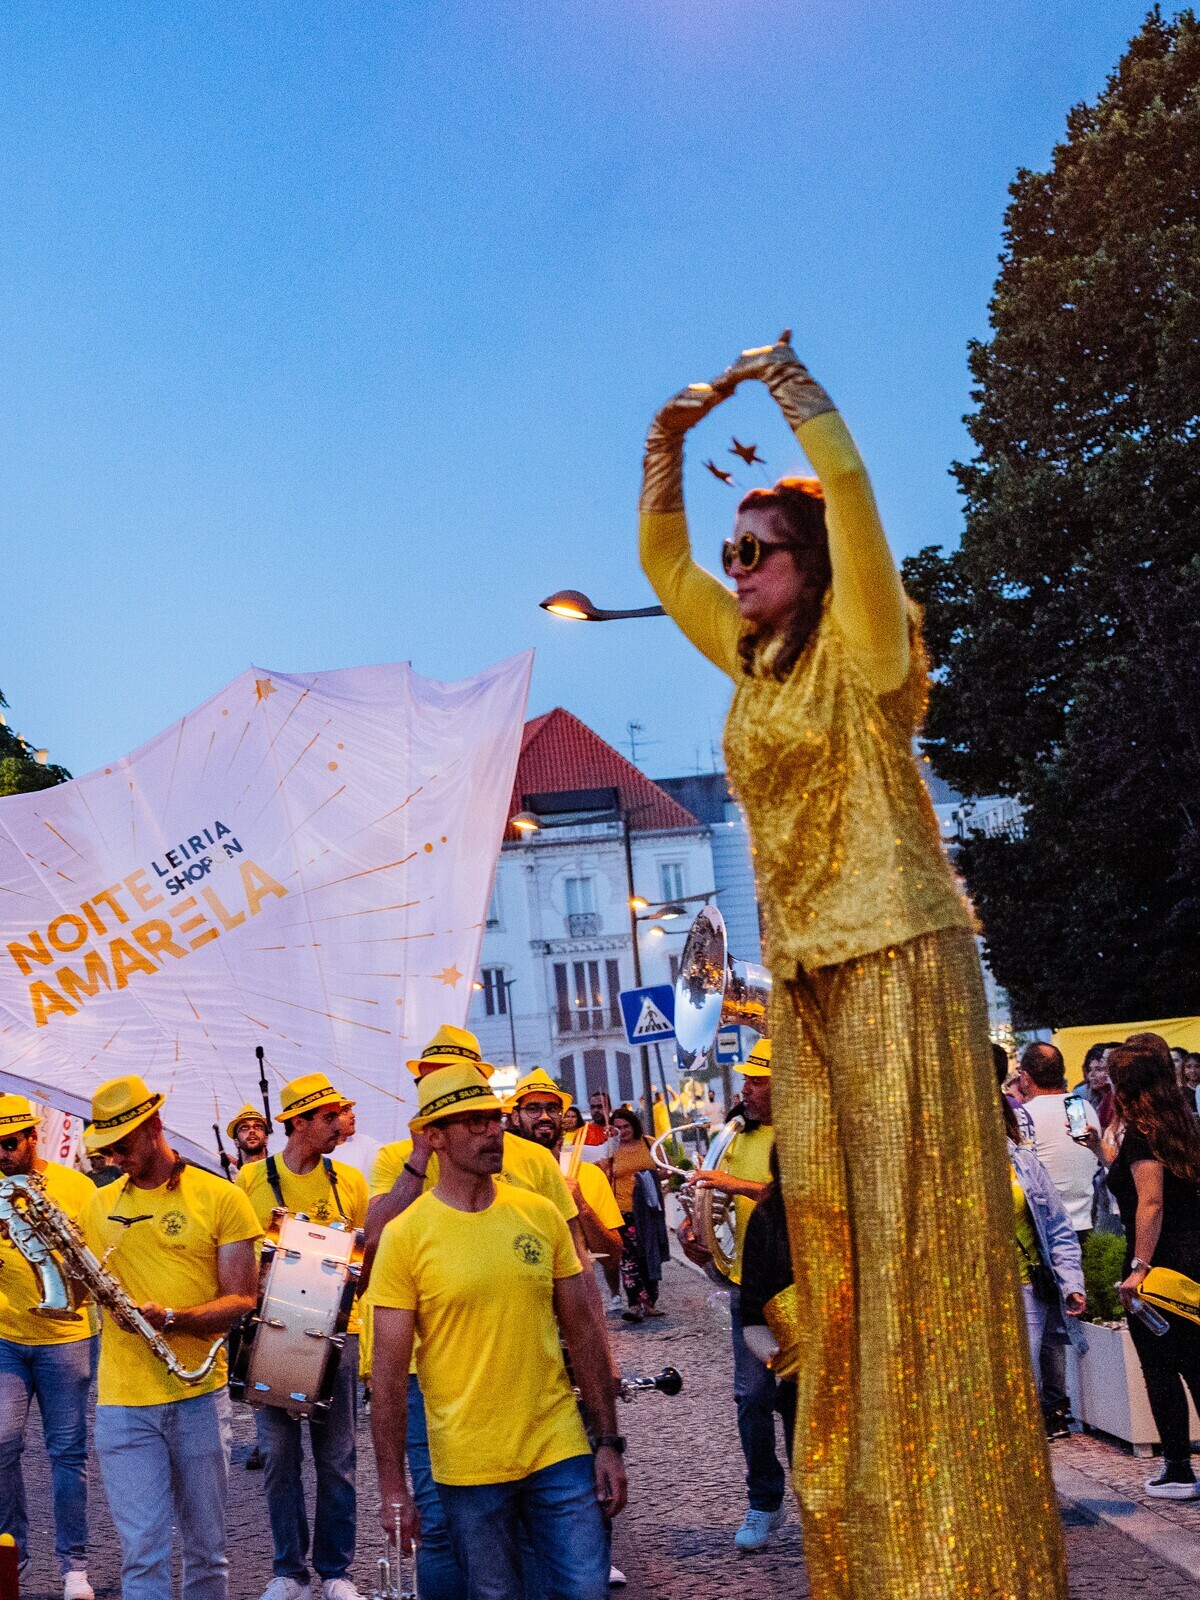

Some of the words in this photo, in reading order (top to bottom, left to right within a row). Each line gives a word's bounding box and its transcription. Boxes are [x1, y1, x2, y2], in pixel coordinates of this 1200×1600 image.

[151, 820, 231, 877] LEIRIA
[6, 867, 165, 976] NOITE
[28, 858, 289, 1028] AMARELA
